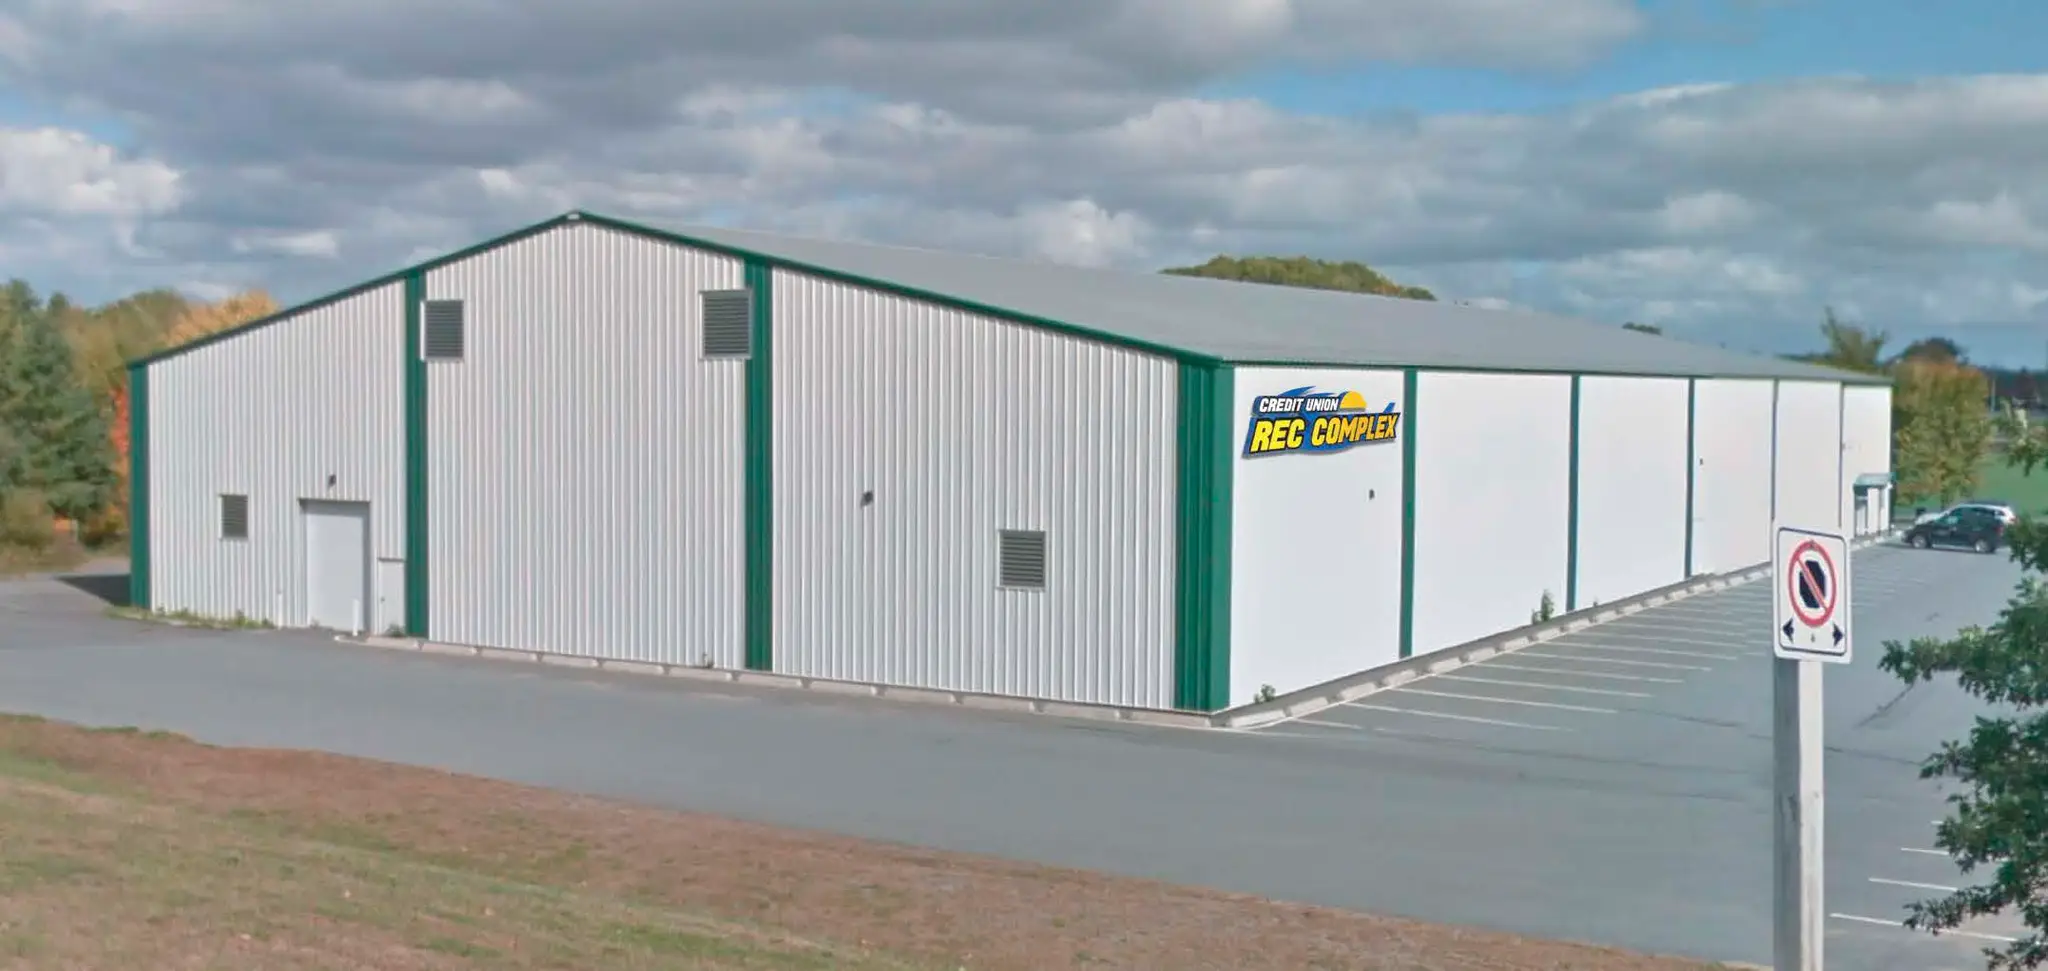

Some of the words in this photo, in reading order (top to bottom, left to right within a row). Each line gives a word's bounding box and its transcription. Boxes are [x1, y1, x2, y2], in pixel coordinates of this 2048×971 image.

[1259, 397, 1304, 412] CREDIT
[1306, 396, 1340, 411] UNION
[1250, 419, 1305, 452] REC
[1311, 414, 1399, 447] COMPLEX
